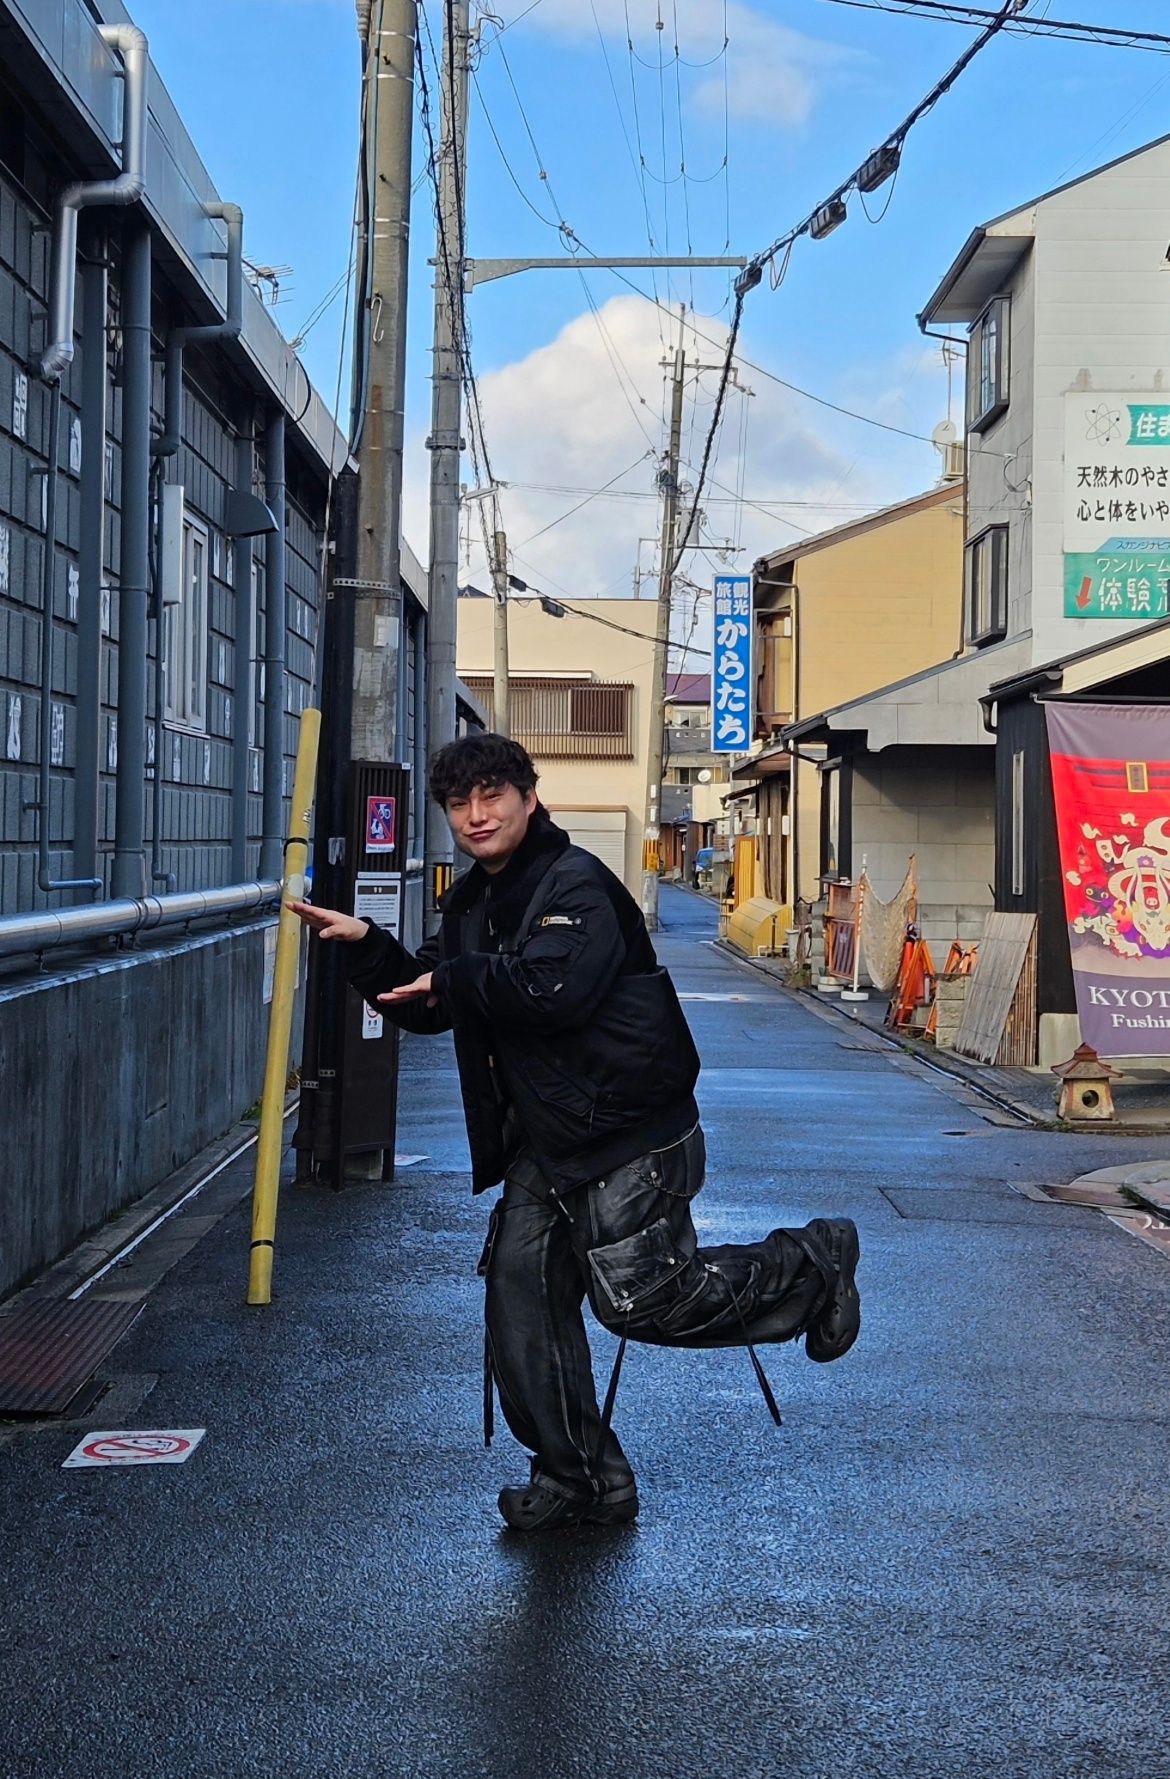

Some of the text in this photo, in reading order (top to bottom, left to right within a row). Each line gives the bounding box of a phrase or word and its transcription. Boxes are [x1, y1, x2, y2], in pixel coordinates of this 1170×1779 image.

[1077, 465, 1169, 488] 天然木のやさ
[1077, 499, 1169, 522] 心と体をいや
[716, 618, 748, 745] からたち
[1088, 985, 1170, 1008] KYOT
